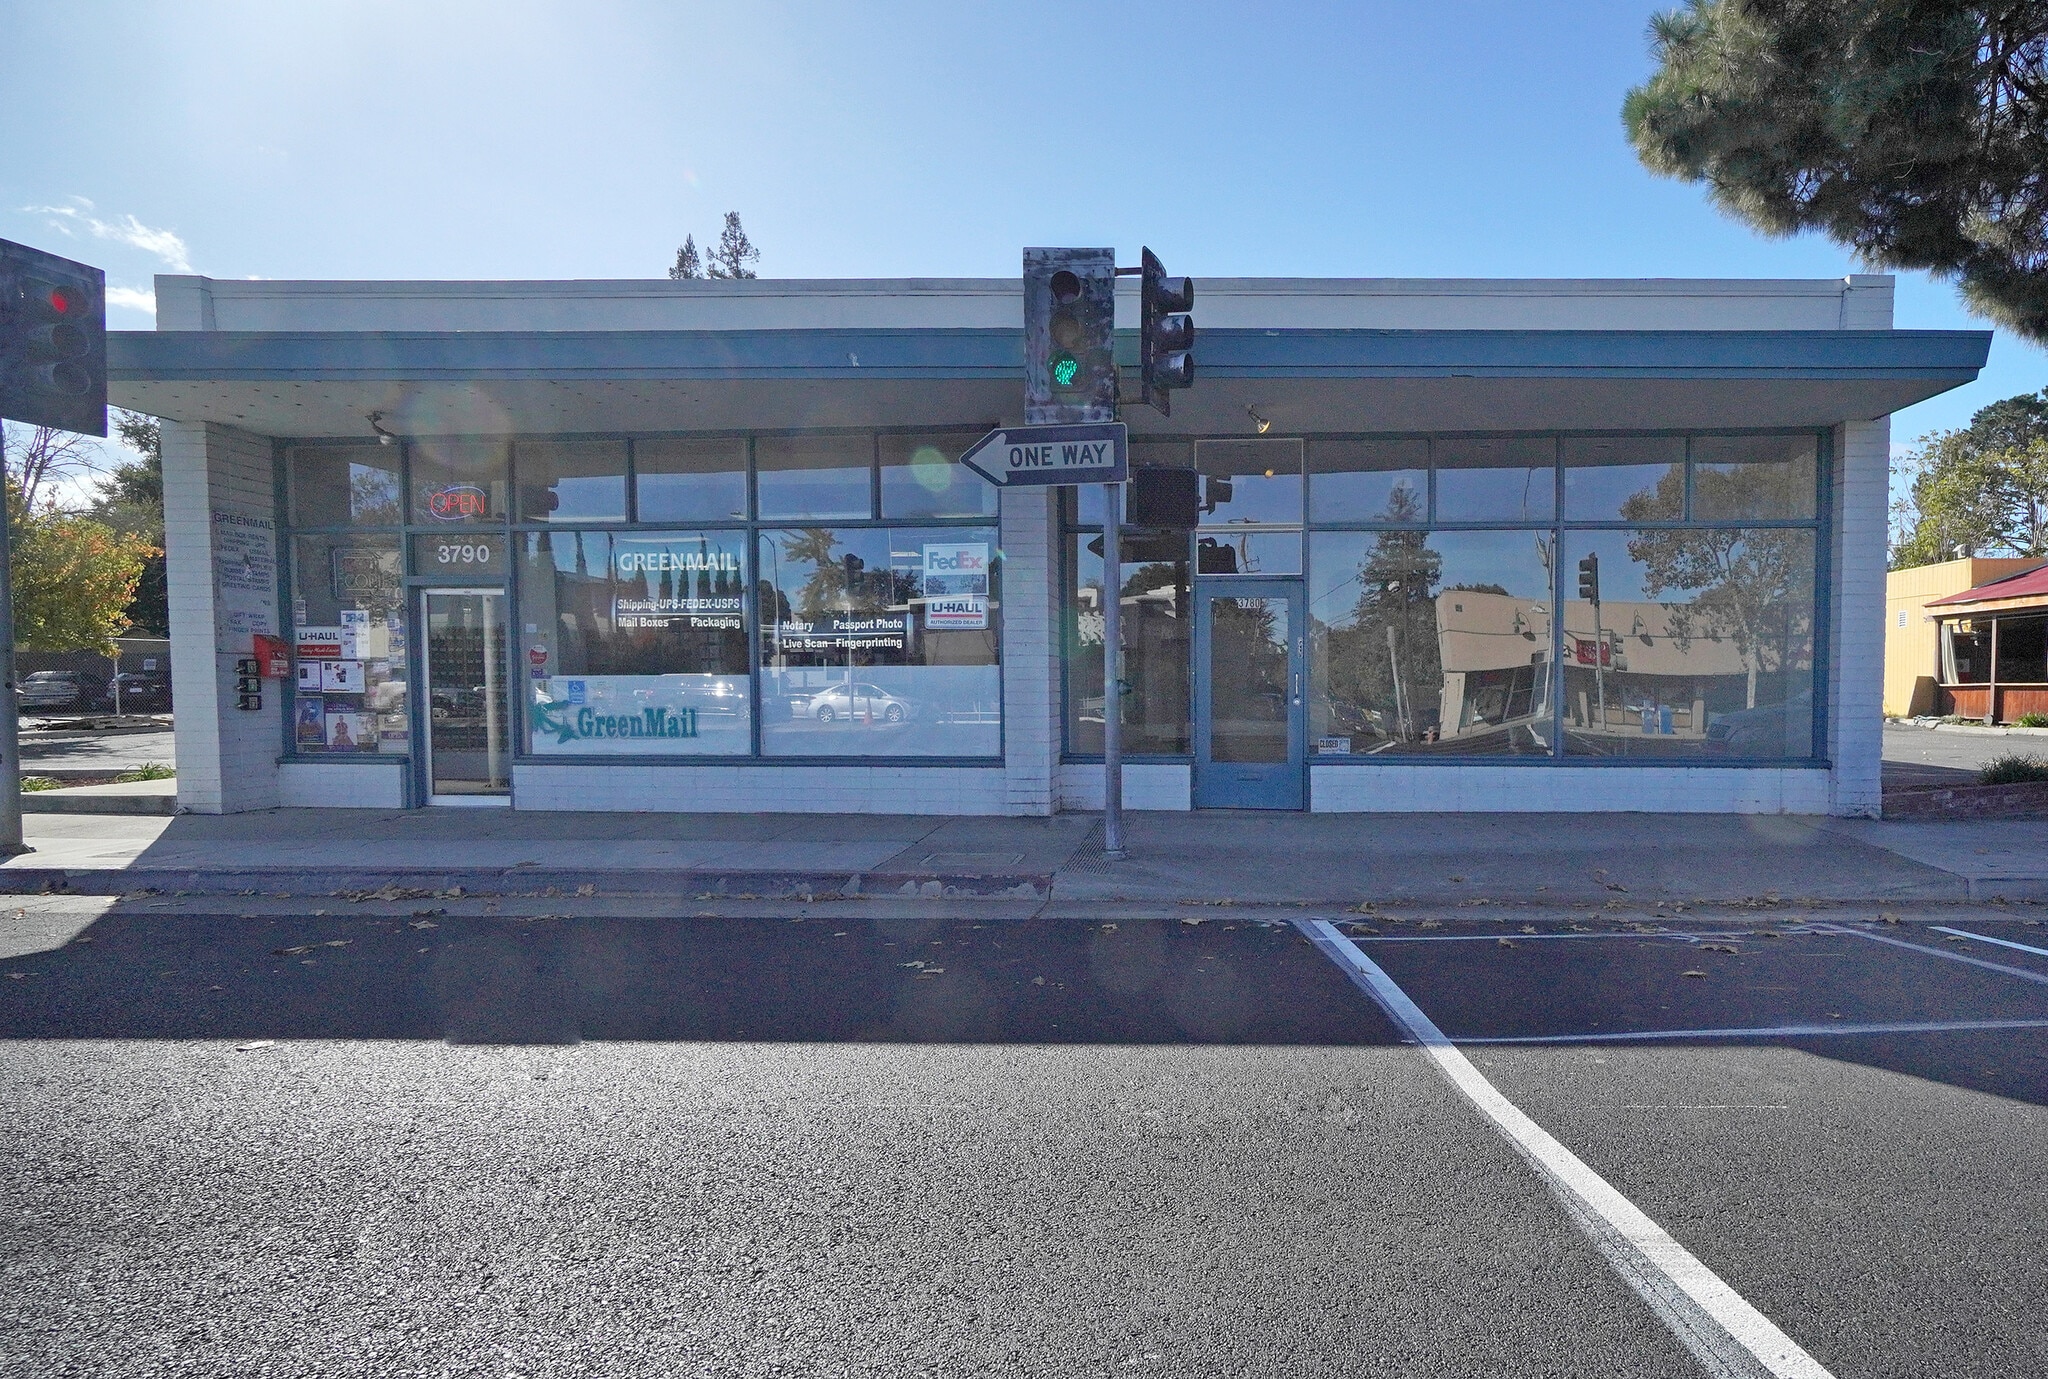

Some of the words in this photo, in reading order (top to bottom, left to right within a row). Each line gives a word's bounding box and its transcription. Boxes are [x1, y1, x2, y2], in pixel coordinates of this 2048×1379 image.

[1010, 446, 1053, 467] ONE
[1062, 444, 1107, 465] WAY
[430, 493, 484, 514] OPEN
[213, 512, 274, 530] GREENMAIL
[438, 545, 490, 564] 3790
[619, 552, 738, 571] GREENMAIL
[928, 551, 983, 569] FedEx
[931, 603, 982, 613] U-HAUL
[1238, 598, 1260, 608] 3780
[618, 617, 638, 627] Mail
[640, 617, 669, 627] Boxes
[690, 616, 741, 629] Packaging
[782, 620, 814, 632] Notary
[833, 619, 874, 632] Passport
[876, 618, 903, 629] Photo
[299, 632, 339, 641] U-HAUL
[783, 638, 802, 649] Live
[804, 638, 828, 648] Scan
[836, 637, 903, 650] Fingerprinting
[578, 706, 698, 738] GreenMail
